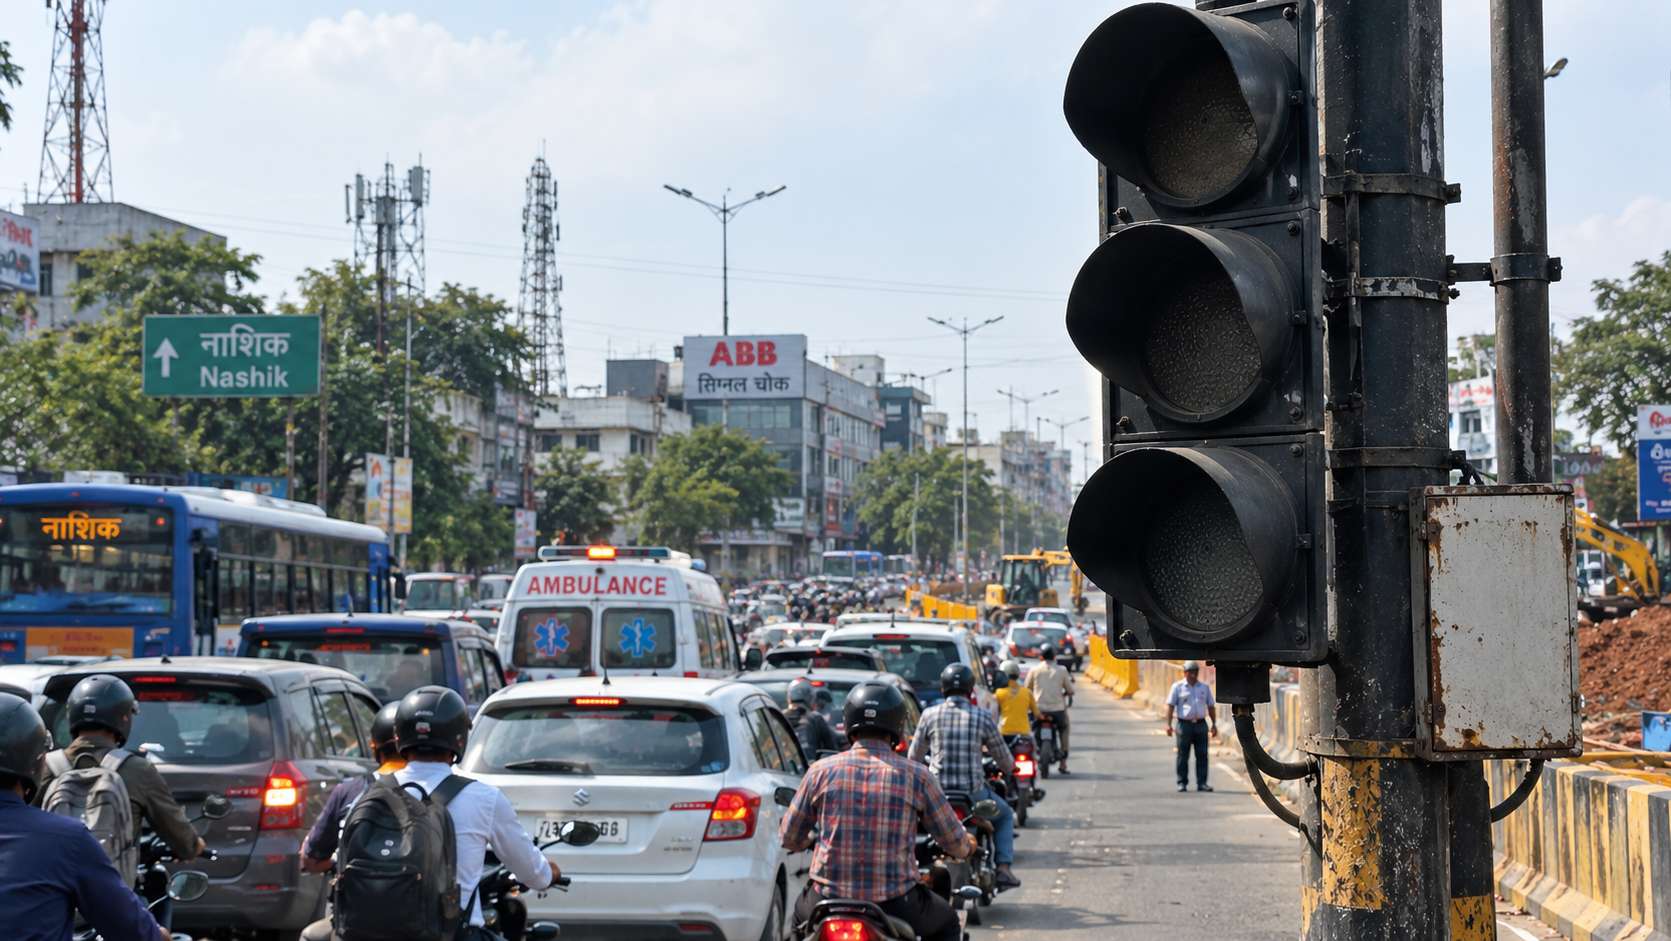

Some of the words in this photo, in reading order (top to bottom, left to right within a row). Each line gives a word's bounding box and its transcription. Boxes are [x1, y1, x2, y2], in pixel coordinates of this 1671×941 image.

[200, 324, 290, 358] नाशिक
[709, 340, 777, 367] ABB
[200, 365, 288, 388] Nashik
[698, 372, 748, 394] सिग्नल
[754, 371, 791, 392] चोक
[41, 511, 123, 540] नाशिक
[527, 575, 667, 596] AMBULANCE
